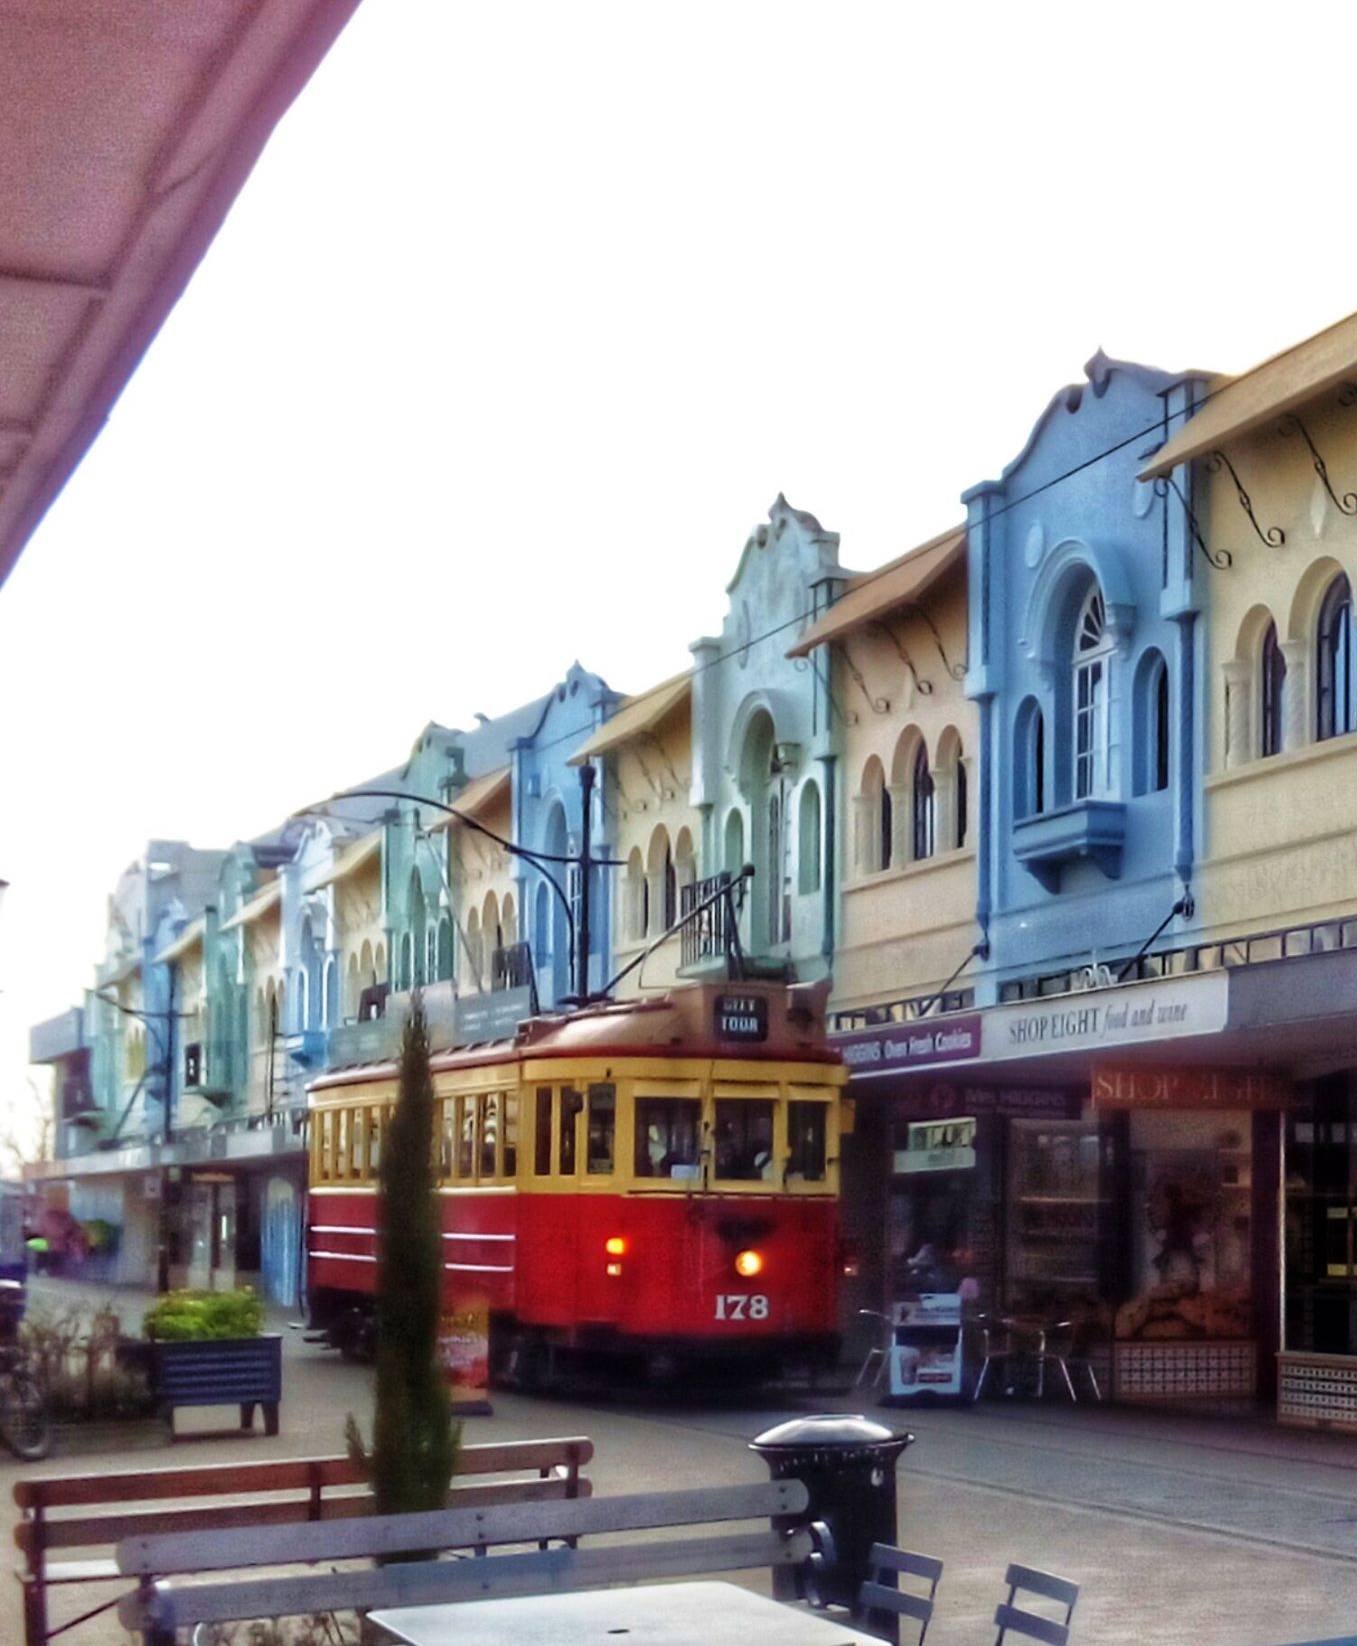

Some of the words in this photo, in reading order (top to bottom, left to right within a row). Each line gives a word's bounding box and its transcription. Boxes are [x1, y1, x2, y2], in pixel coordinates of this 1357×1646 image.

[721, 1016, 758, 1033] TOUR
[1009, 1016, 1050, 1044] SHOP
[1051, 1007, 1101, 1038] EIGHT
[1131, 1000, 1156, 1027] and
[714, 1294, 768, 1320] 178
